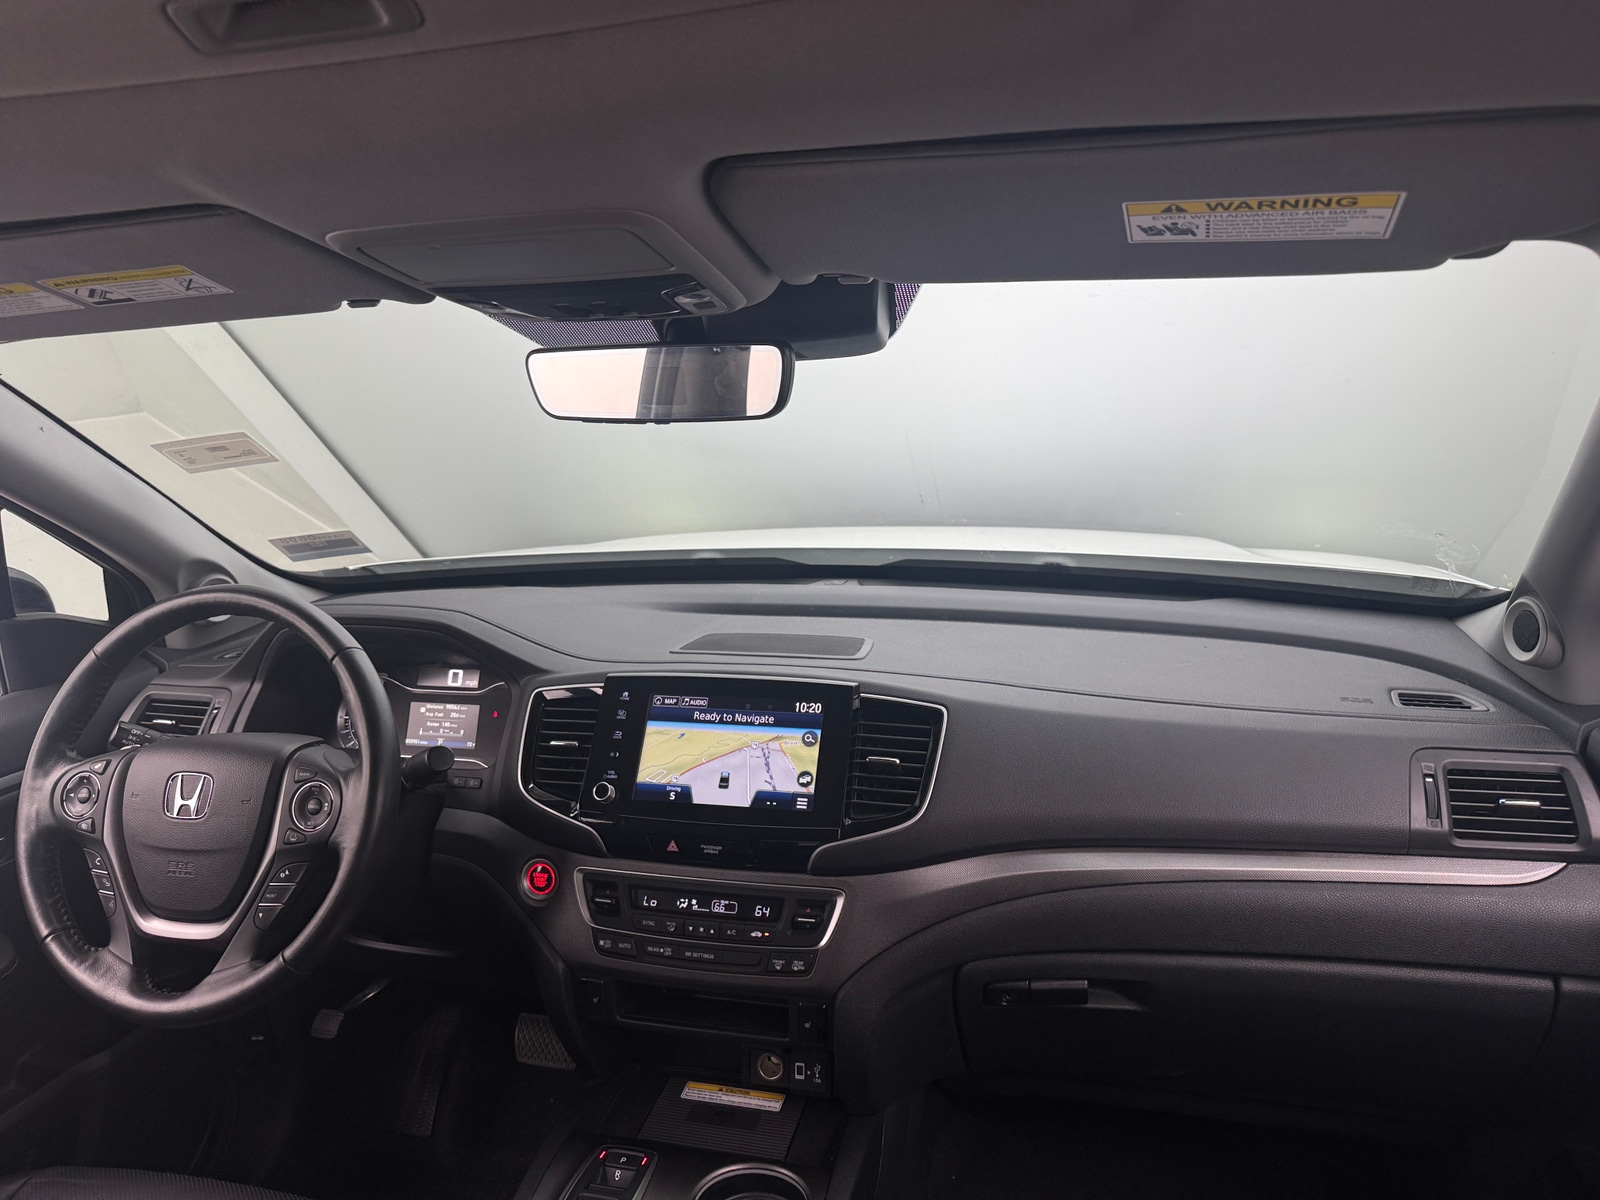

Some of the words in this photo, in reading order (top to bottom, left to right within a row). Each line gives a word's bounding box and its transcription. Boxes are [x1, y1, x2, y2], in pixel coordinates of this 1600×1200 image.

[1205, 197, 1358, 212] WARNING
[795, 702, 822, 714] 10:20
[693, 711, 721, 723] Ready
[723, 713, 733, 721] to
[735, 714, 775, 724] Navigate
[754, 905, 771, 917] 64
[619, 1156, 627, 1164] P
[614, 1169, 622, 1178] R
